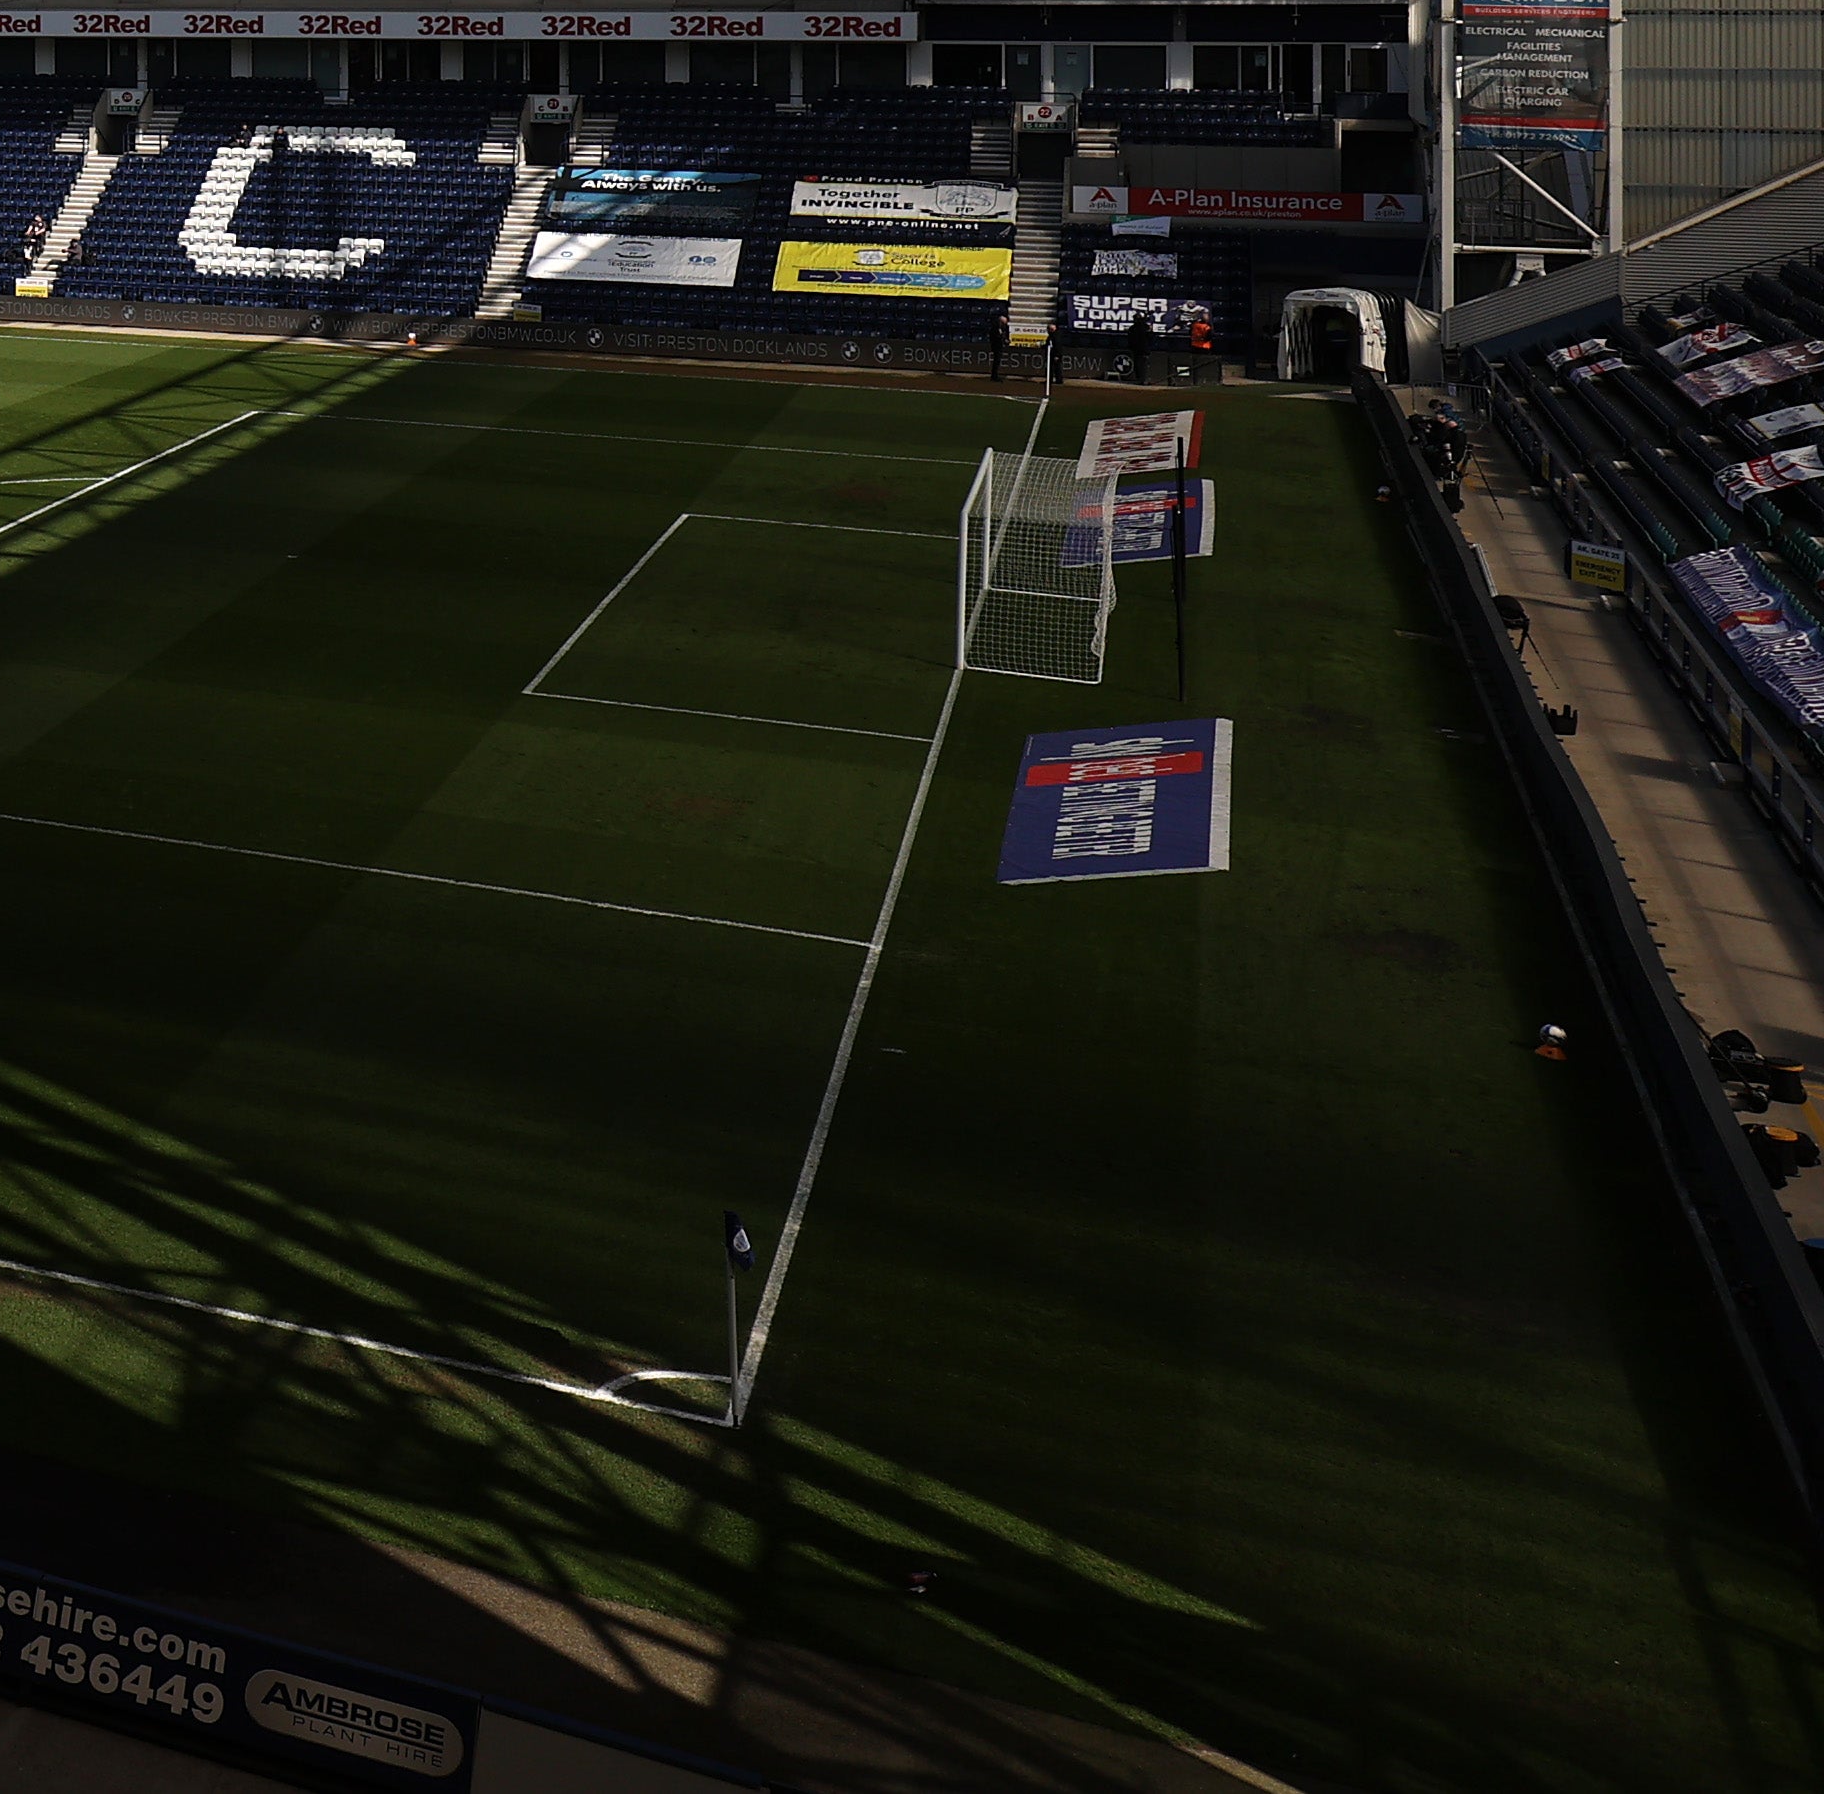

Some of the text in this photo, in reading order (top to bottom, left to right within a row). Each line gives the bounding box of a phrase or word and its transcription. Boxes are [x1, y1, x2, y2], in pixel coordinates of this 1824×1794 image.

[184, 15, 263, 34] 32Red
[418, 15, 503, 35] 32Red
[670, 16, 763, 36] 32Red
[804, 16, 901, 37] 32Red
[1465, 26, 1605, 39] ELECTRICAL MECHANICAL
[1506, 42, 1561, 51] FACILITIES
[1496, 53, 1573, 63] MANAGEMENT
[1479, 68, 1589, 79] CARBON REDUCTION
[1496, 86, 1569, 96] ELECTRIC CAR
[1504, 97, 1563, 107] CHARGING
[1040, 108, 1050, 116] 22
[581, 180, 722, 193] Always with us.
[868, 176, 923, 184] Preston
[818, 189, 900, 200] Together
[1148, 189, 1343, 211] A-Plan Insurance
[178, 125, 416, 280] C
[801, 199, 914, 211] INVINCIBLE
[1188, 208, 1302, 218] www.aplan.co.uk/preston
[826, 218, 980, 231] www.pne-online.net
[891, 258, 946, 267] College
[1073, 295, 1168, 312] SUPER
[1073, 320, 1167, 333] CLARE
[35, 302, 112, 319] DOCKLANDS
[144, 308, 200, 323] BOWKER
[202, 311, 265, 328] PRESTON
[268, 315, 300, 330] BMW
[332, 319, 577, 344] WWW.BOWKERPRESTONBMW.CO.UK
[613, 332, 654, 349] VISIT:
[656, 333, 728, 352] PRESTON
[732, 337, 829, 358] DOCKLANDS
[903, 347, 973, 366] BOWKER
[1061, 354, 1103, 371] BMW
[1575, 560, 1620, 575] EMERGENCY
[20, 1634, 225, 1725] 436449
[261, 1682, 444, 1746] AMBROSE
[292, 1716, 443, 1769] PLANT HIRE
